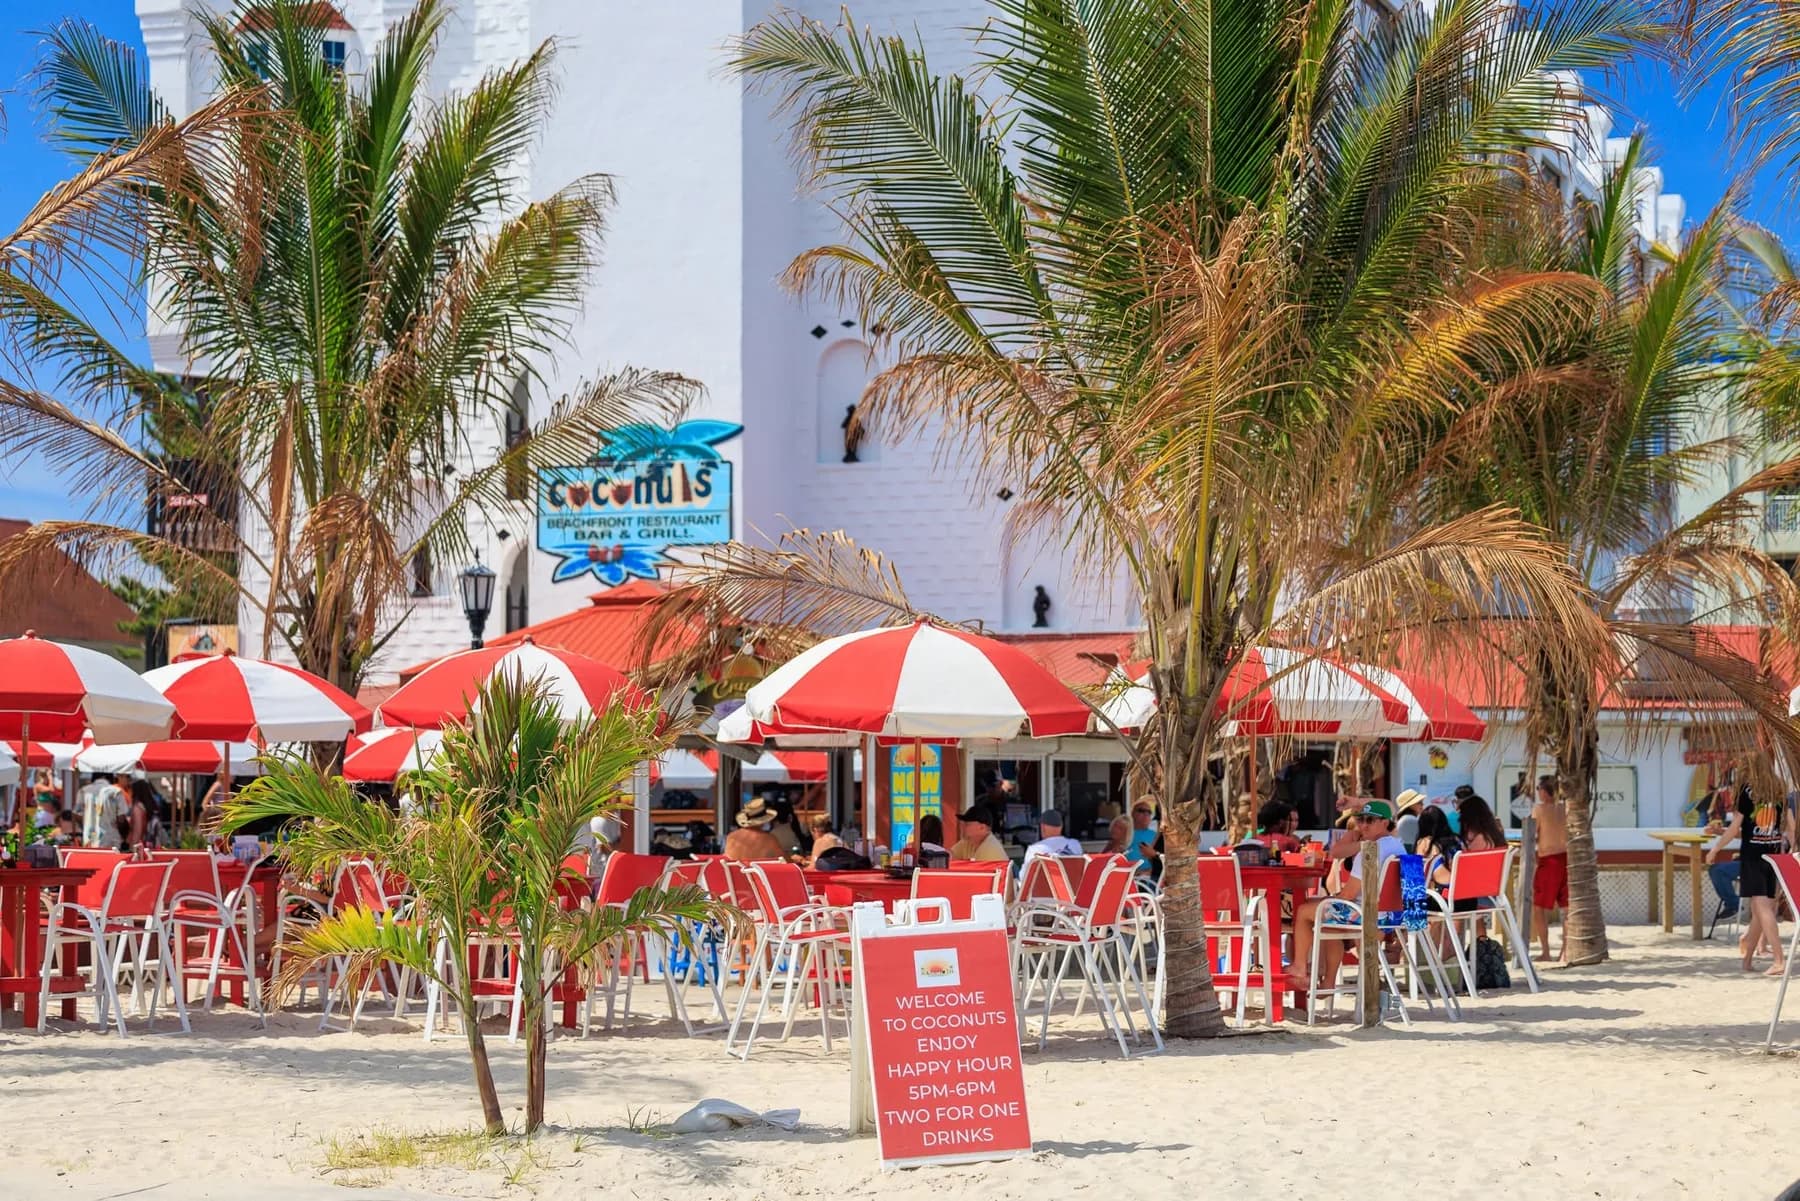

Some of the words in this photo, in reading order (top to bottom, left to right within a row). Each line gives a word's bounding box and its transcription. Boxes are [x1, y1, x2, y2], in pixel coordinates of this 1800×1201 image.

[547, 517, 632, 529] BEACHFRONT
[637, 515, 721, 526] RESTAURANT
[574, 530, 612, 540] BAR
[619, 529, 631, 539] &
[638, 528, 694, 538] GRILL
[896, 991, 985, 1009] WELCOME
[883, 1018, 907, 1032] TO
[911, 1011, 1006, 1030] COCONUTS
[917, 1035, 978, 1053] ENJOY
[888, 1060, 952, 1078] HAPPY
[957, 1056, 1012, 1073] HOUR
[909, 1080, 996, 1100] 5PM-6PM
[884, 1109, 931, 1126] TWO
[936, 1106, 975, 1121] FOR
[979, 1102, 1021, 1119] ONE
[923, 1128, 995, 1147] DRINKS
